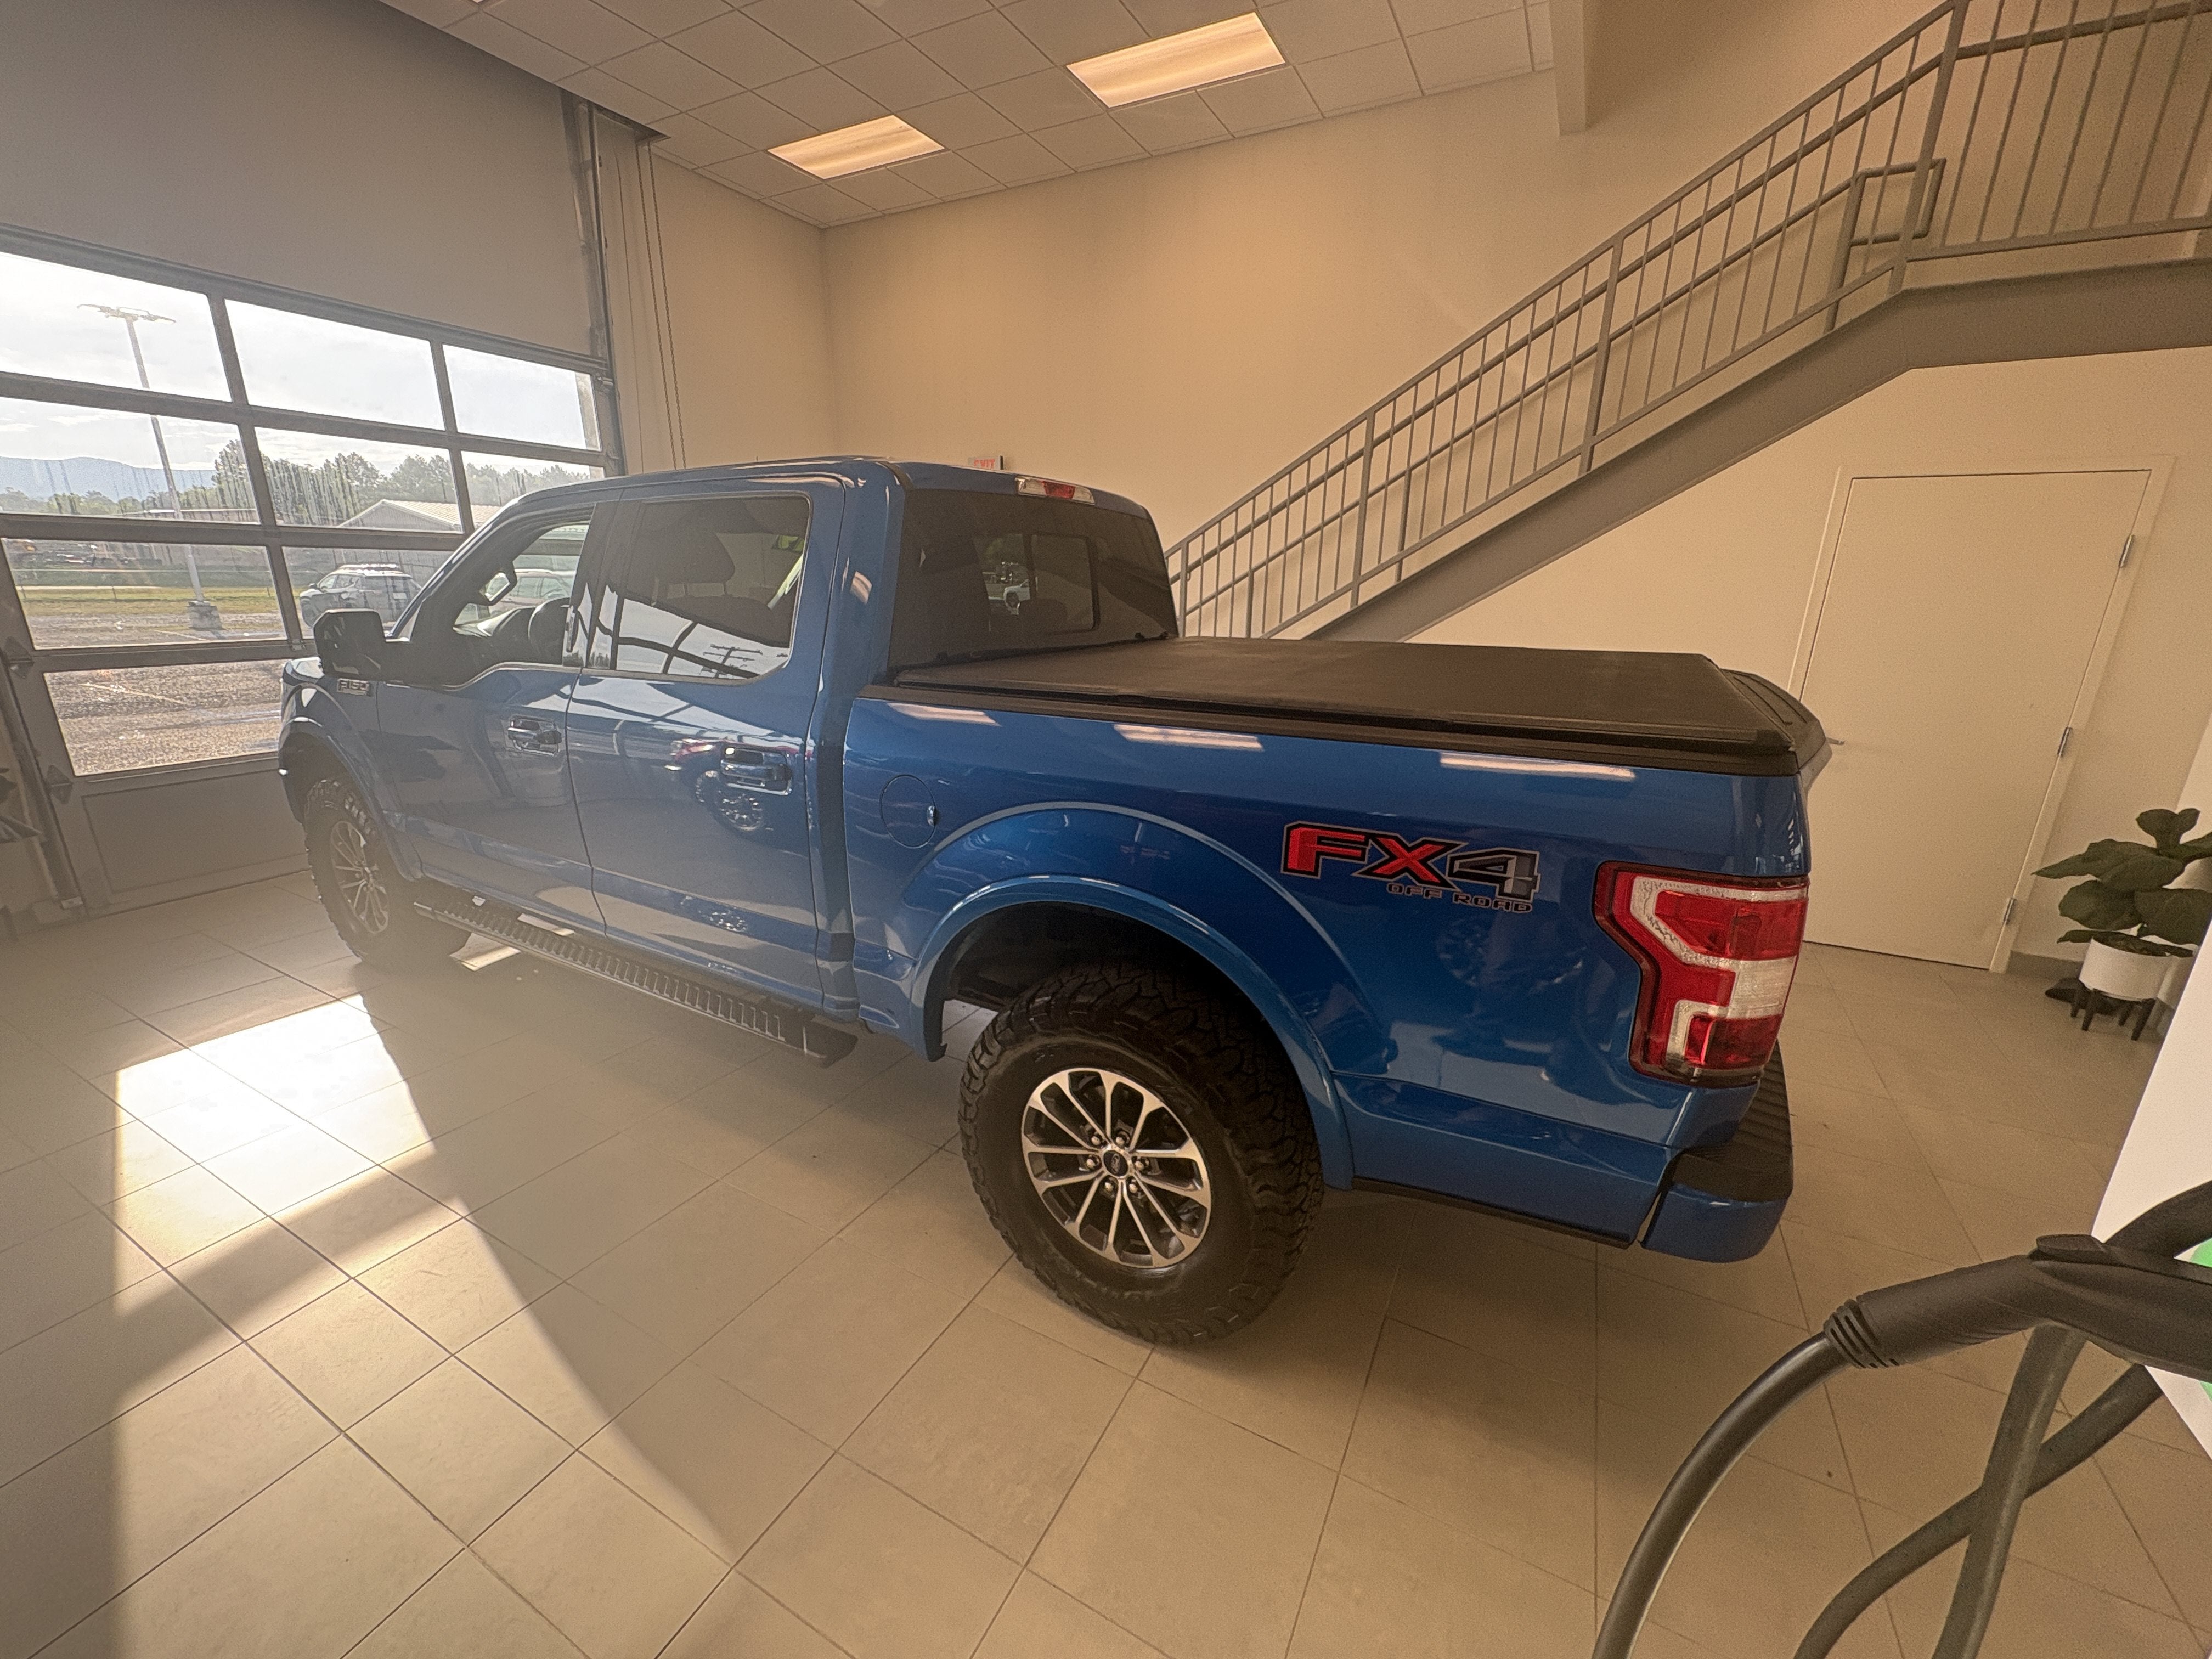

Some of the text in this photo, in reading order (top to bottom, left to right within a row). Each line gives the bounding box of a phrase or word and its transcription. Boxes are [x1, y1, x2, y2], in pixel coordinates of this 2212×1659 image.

[1280, 821, 1540, 900] FX4
[1387, 883, 1533, 913] OFF ROAD
